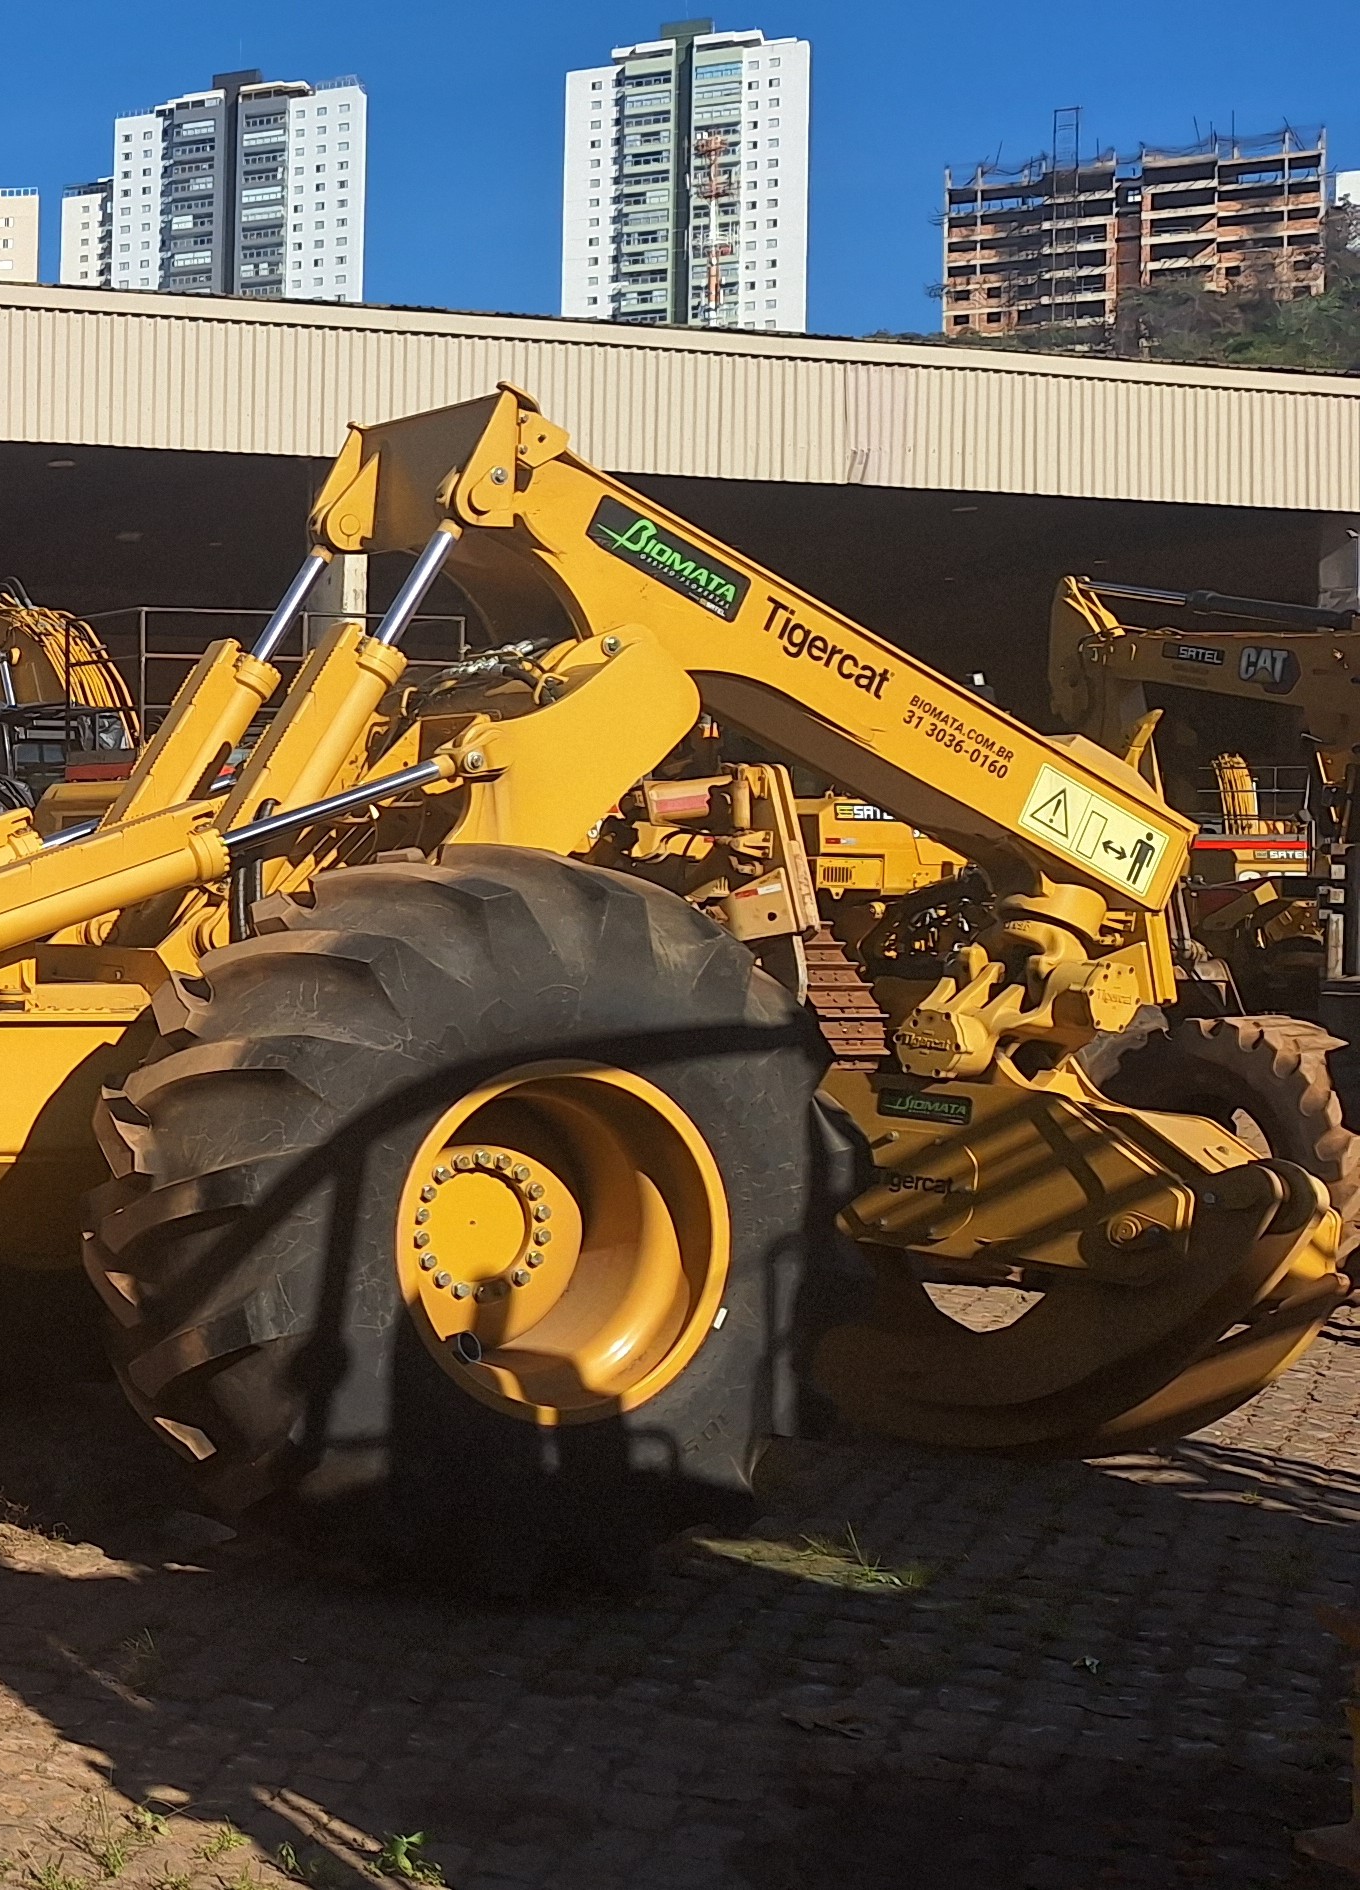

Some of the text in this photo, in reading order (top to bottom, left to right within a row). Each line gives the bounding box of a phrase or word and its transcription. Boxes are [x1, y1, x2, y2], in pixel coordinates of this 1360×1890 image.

[596, 519, 736, 603] BIOMATA
[763, 595, 893, 701] Tigercat
[1178, 646, 1223, 665] SATEL
[1240, 646, 1289, 683] CAT
[902, 709, 1009, 779] 31 3036-0160
[909, 694, 1015, 763] BIOMATA.COM.BR
